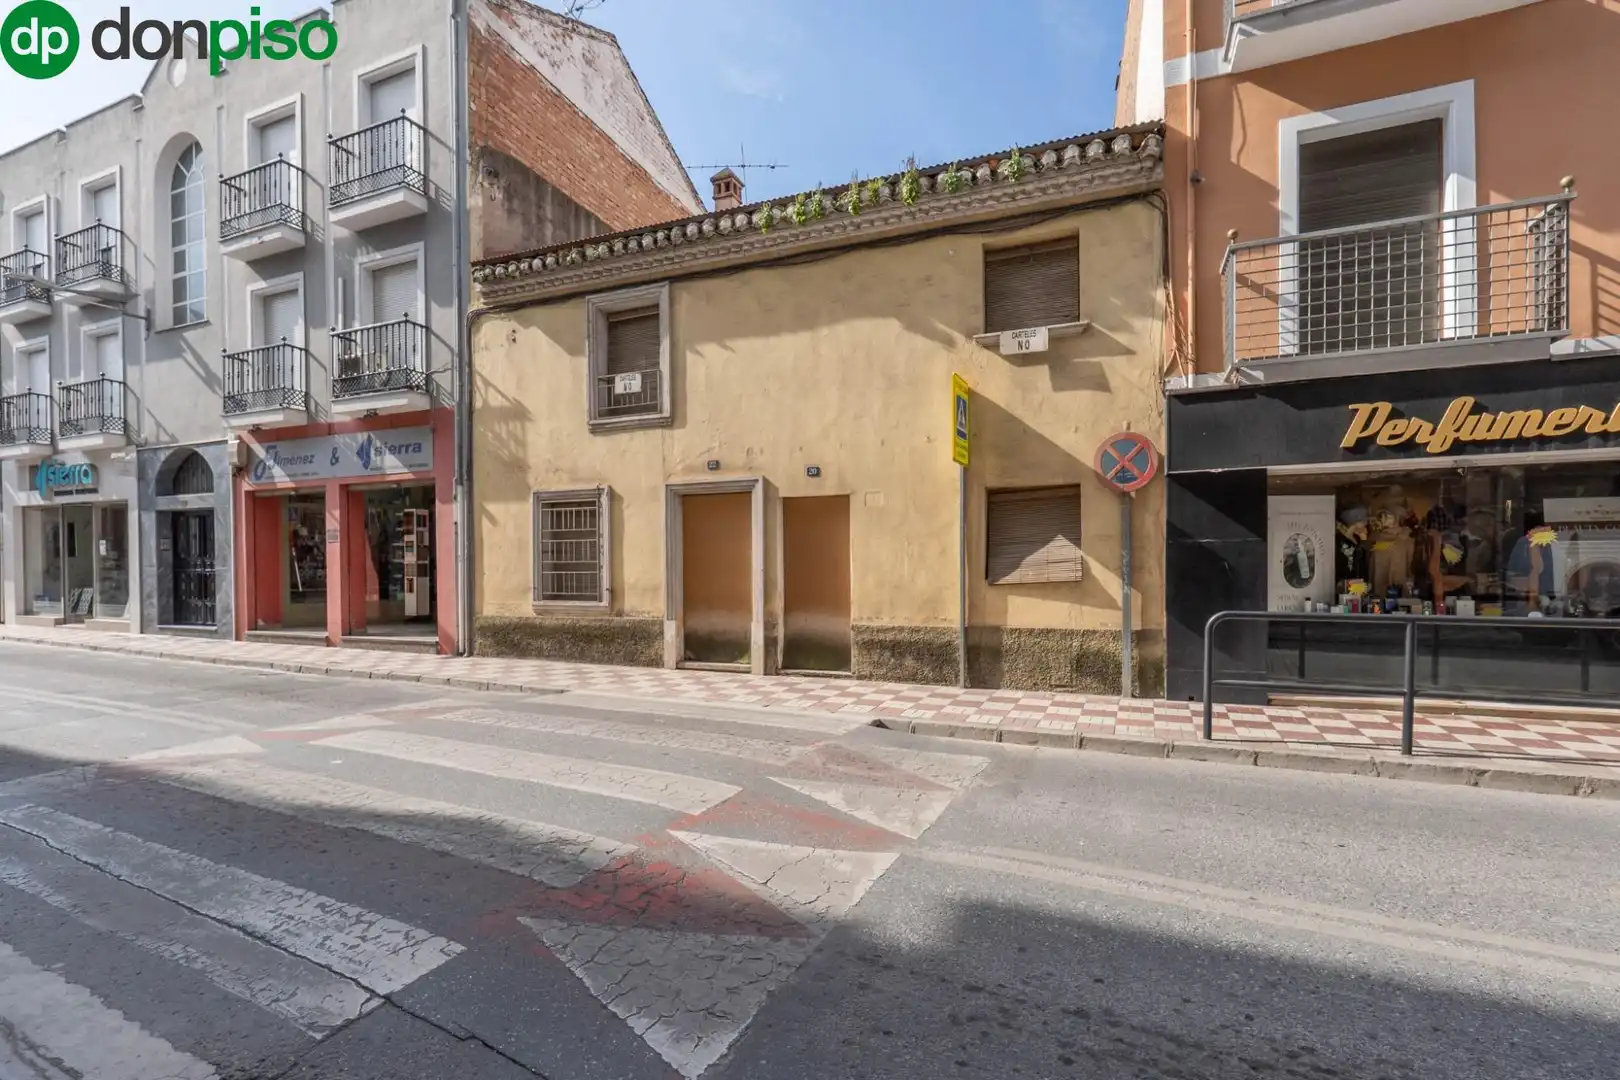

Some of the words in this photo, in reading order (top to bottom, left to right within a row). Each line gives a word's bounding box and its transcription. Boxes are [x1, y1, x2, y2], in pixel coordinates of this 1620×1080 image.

[1011, 329, 1037, 340] CARTELES
[1017, 339, 1031, 351] NO
[374, 441, 422, 457] sierra
